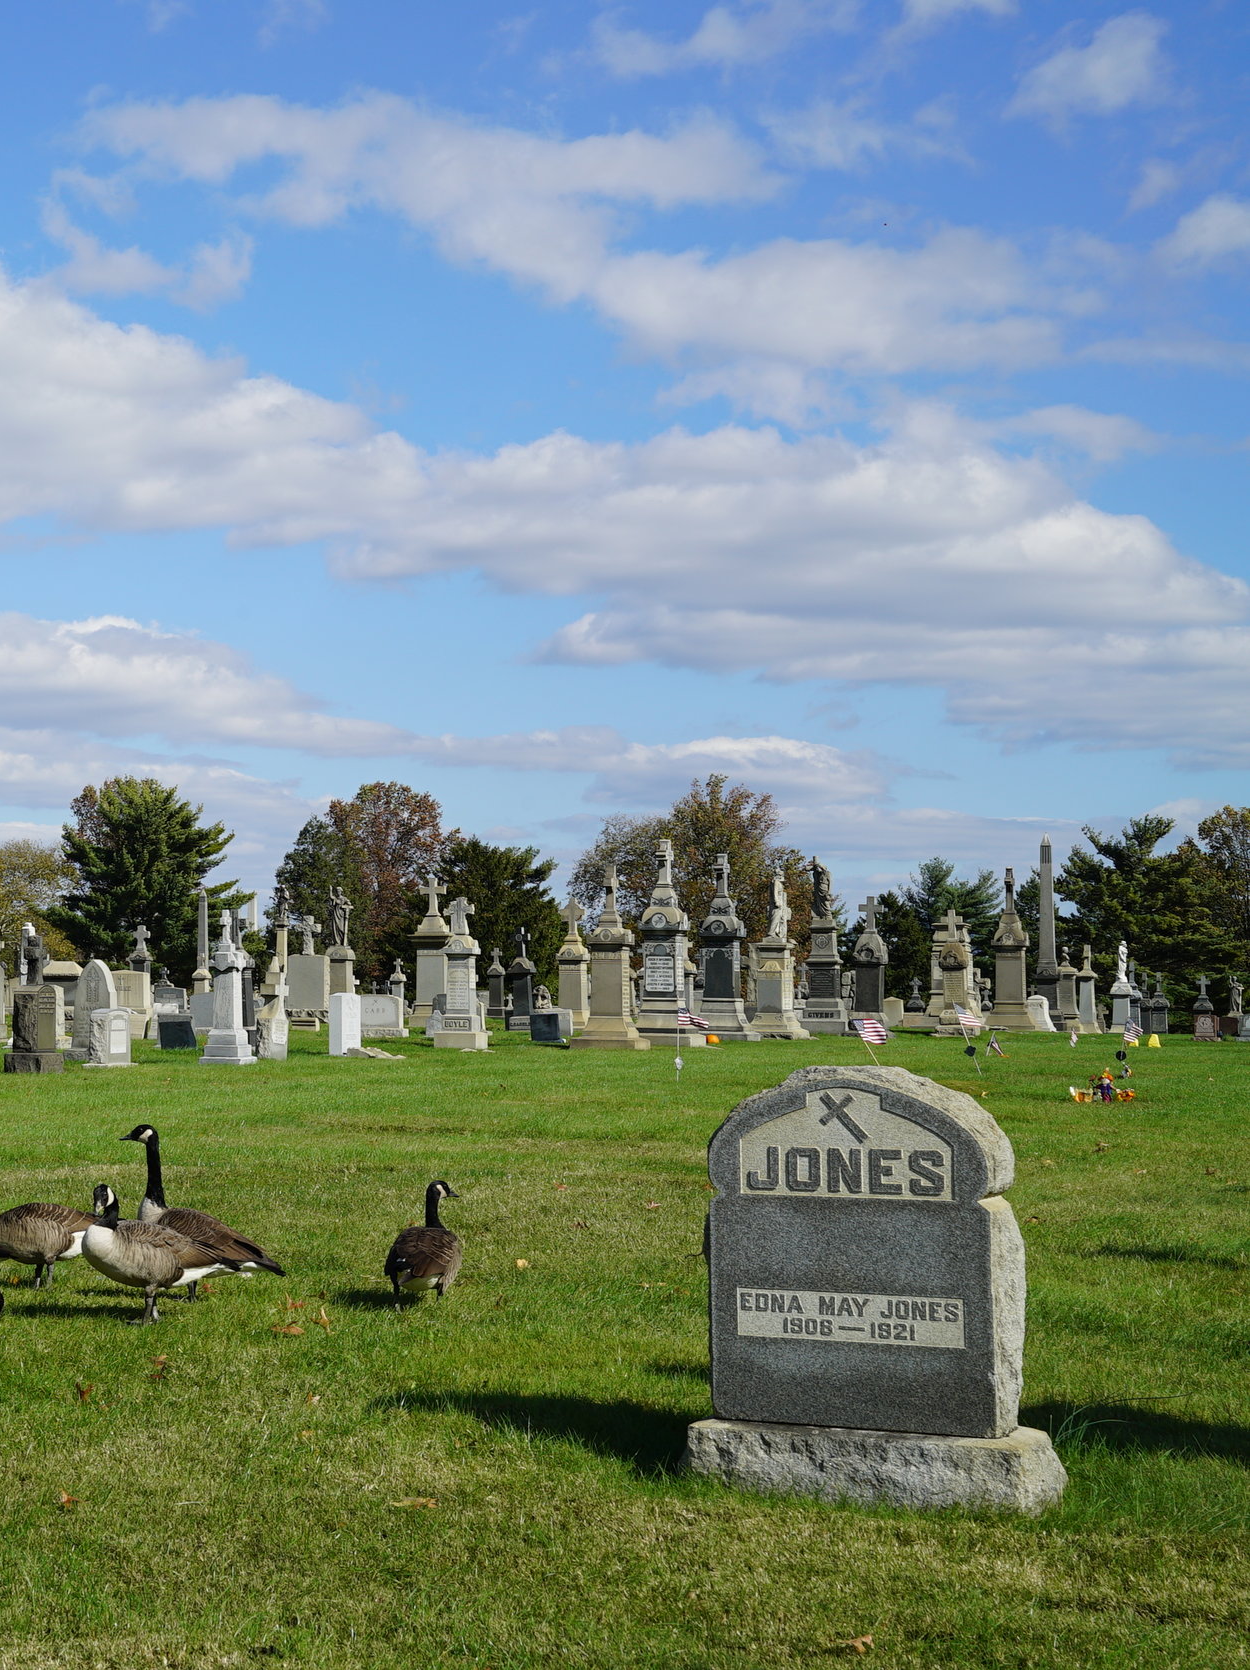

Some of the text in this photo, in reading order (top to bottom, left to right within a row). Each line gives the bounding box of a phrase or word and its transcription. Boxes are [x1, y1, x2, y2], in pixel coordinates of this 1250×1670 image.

[746, 1146, 945, 1197] JONES
[739, 1291, 960, 1323] EDNA MAY JONES
